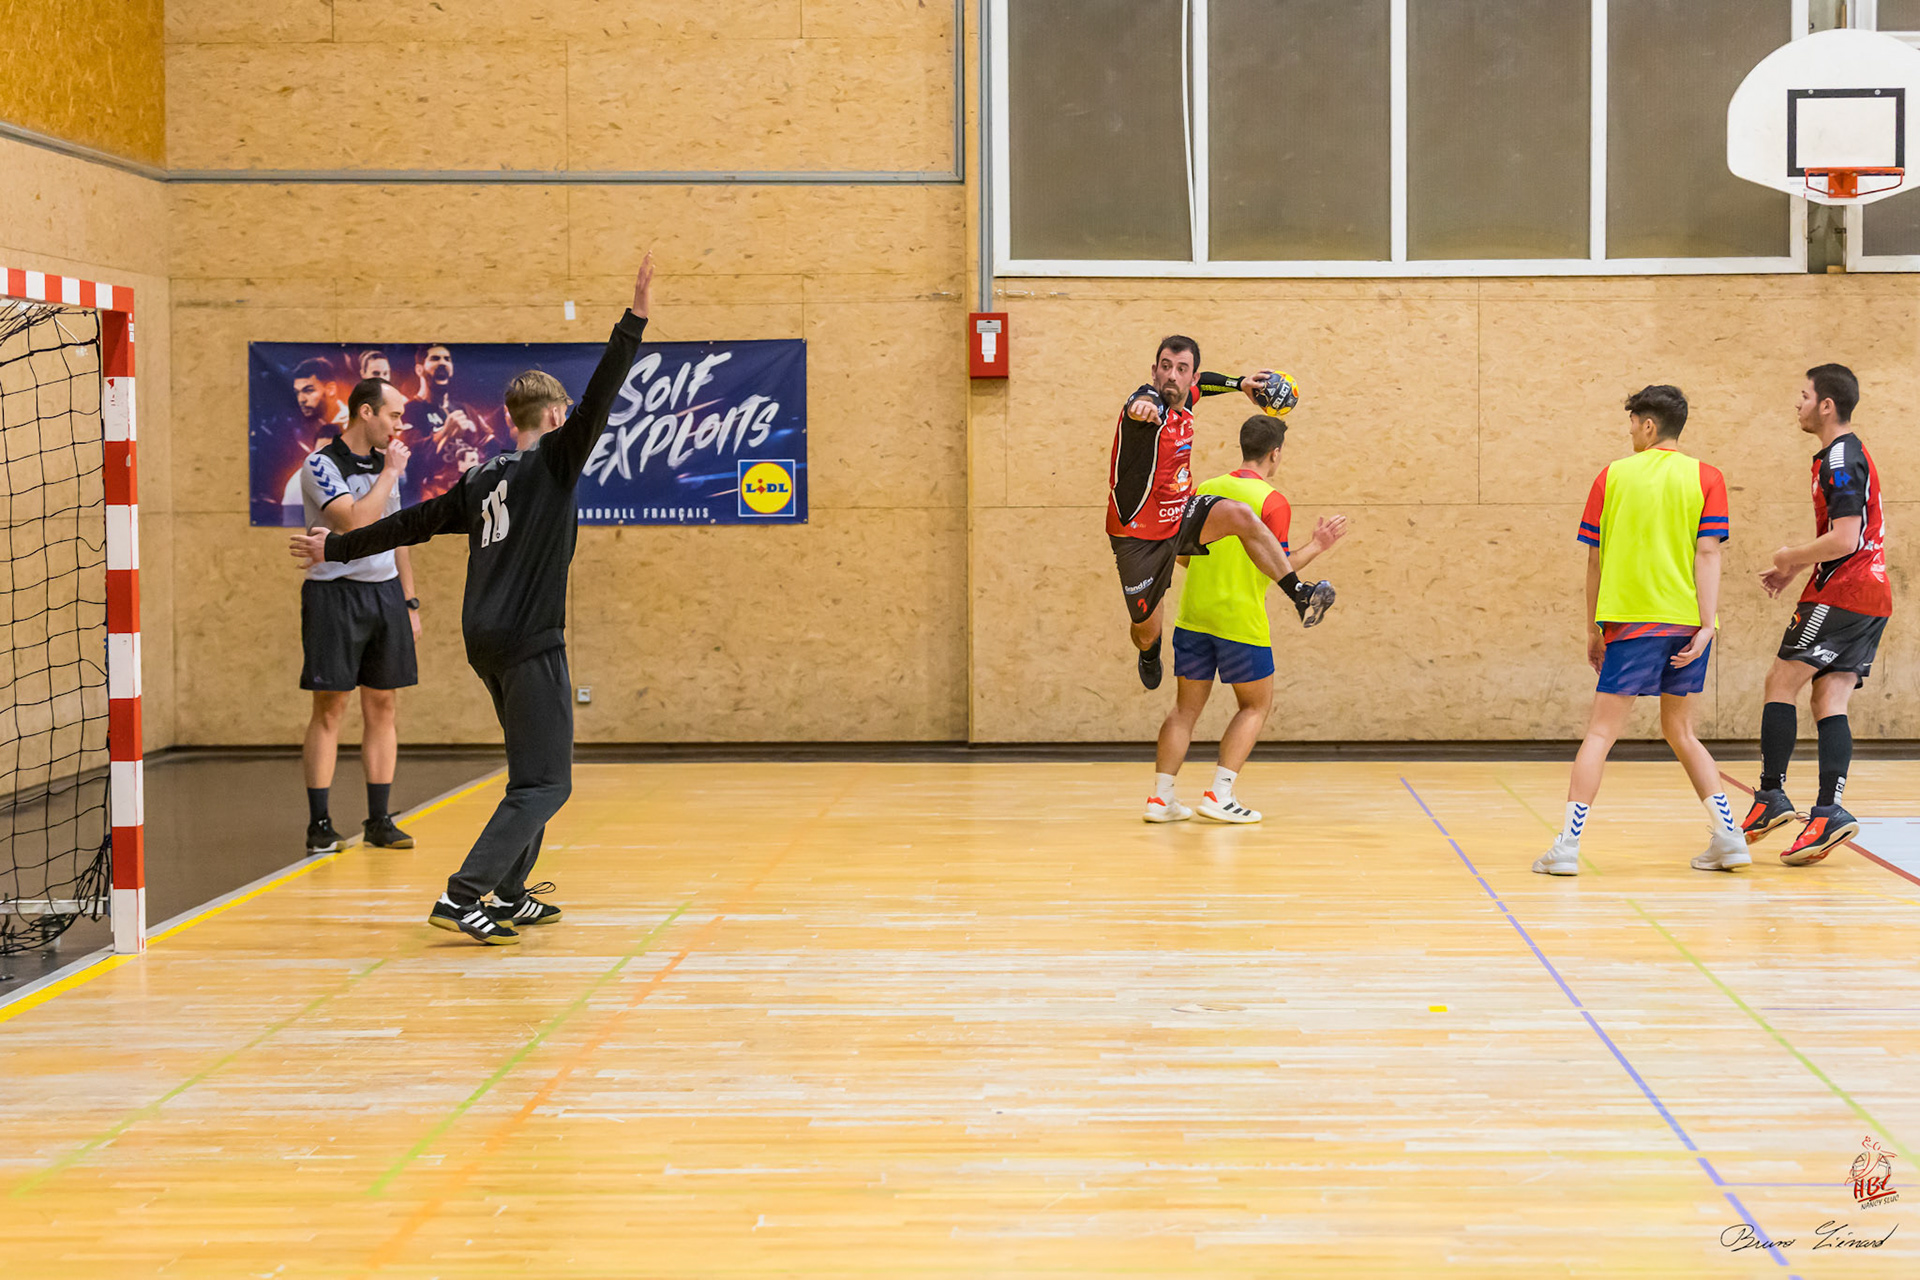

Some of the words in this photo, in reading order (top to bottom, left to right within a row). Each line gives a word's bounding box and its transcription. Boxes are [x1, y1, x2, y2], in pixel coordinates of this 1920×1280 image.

[481, 479, 510, 548] 16
[577, 507, 636, 519] ANDBALL
[643, 507, 709, 522] FRANÇAIS
